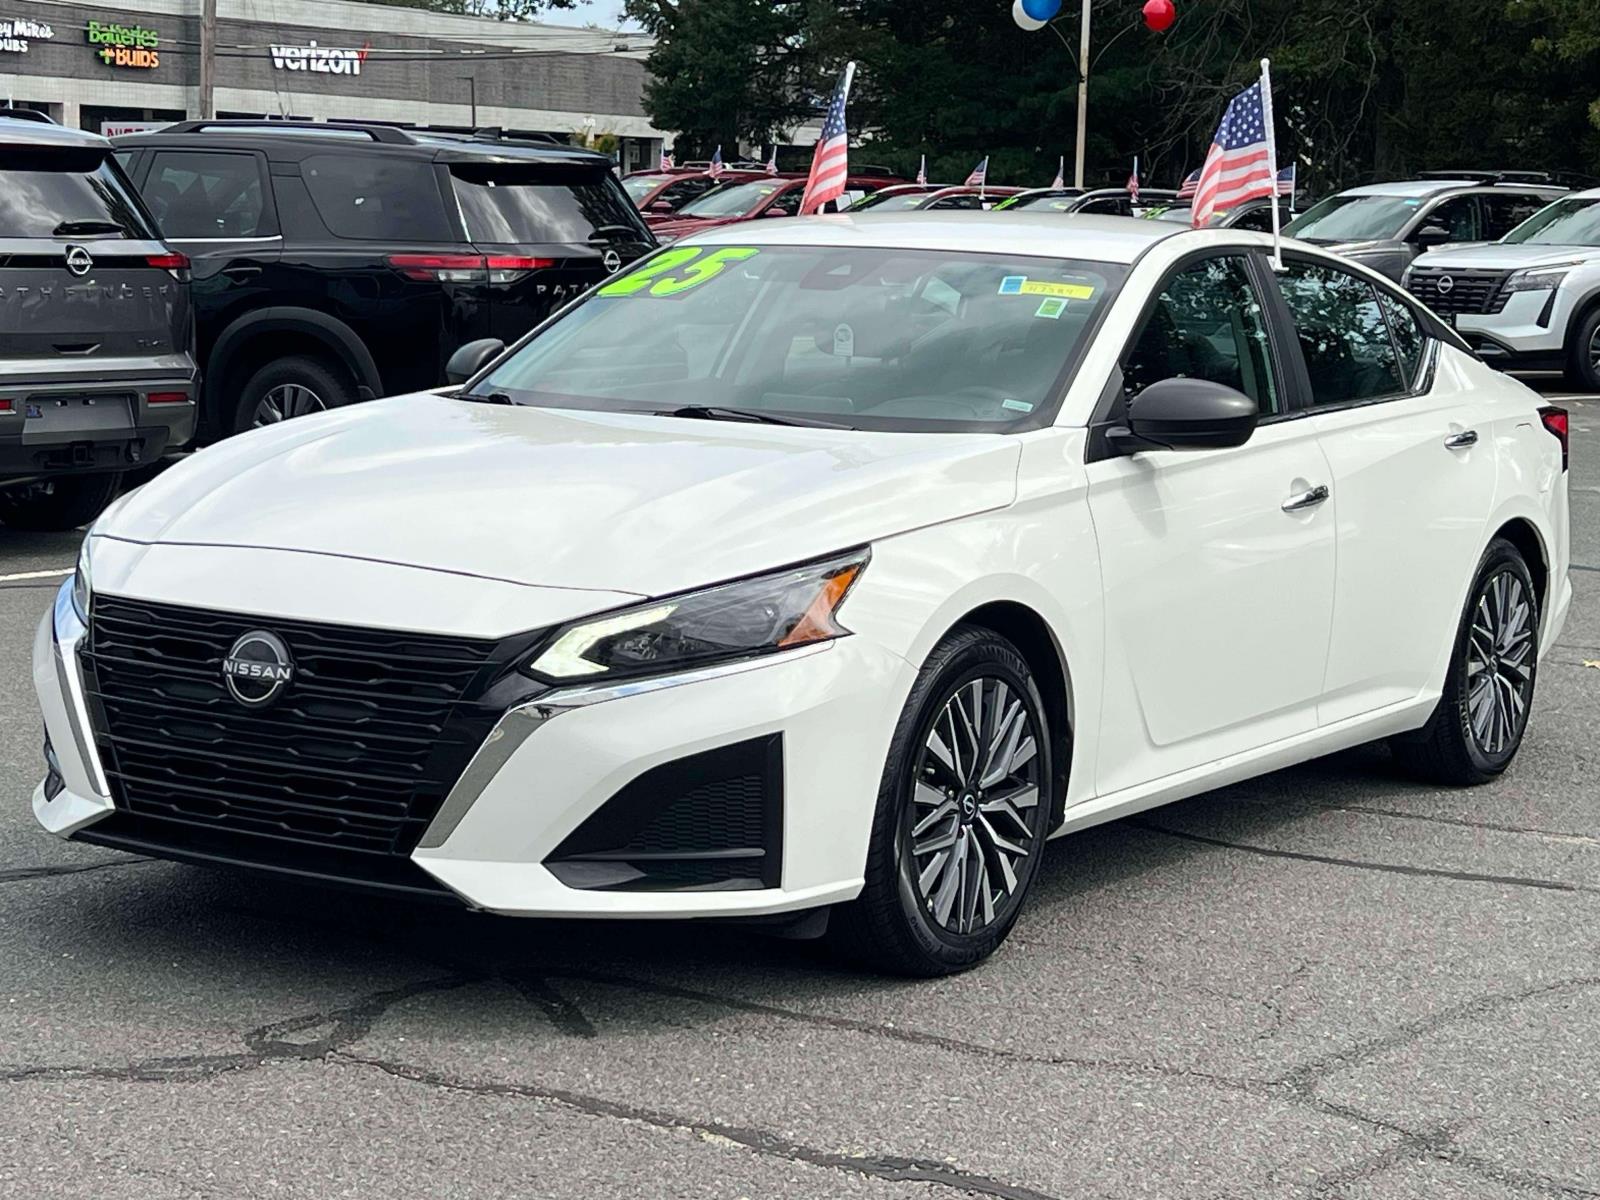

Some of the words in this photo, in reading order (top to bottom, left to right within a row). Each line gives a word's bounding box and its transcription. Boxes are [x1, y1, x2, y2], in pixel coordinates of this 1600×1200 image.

[88, 20, 159, 47] Batteries
[270, 40, 361, 75] verizon
[596, 246, 761, 298] 25
[222, 659, 291, 679] NISSAN
